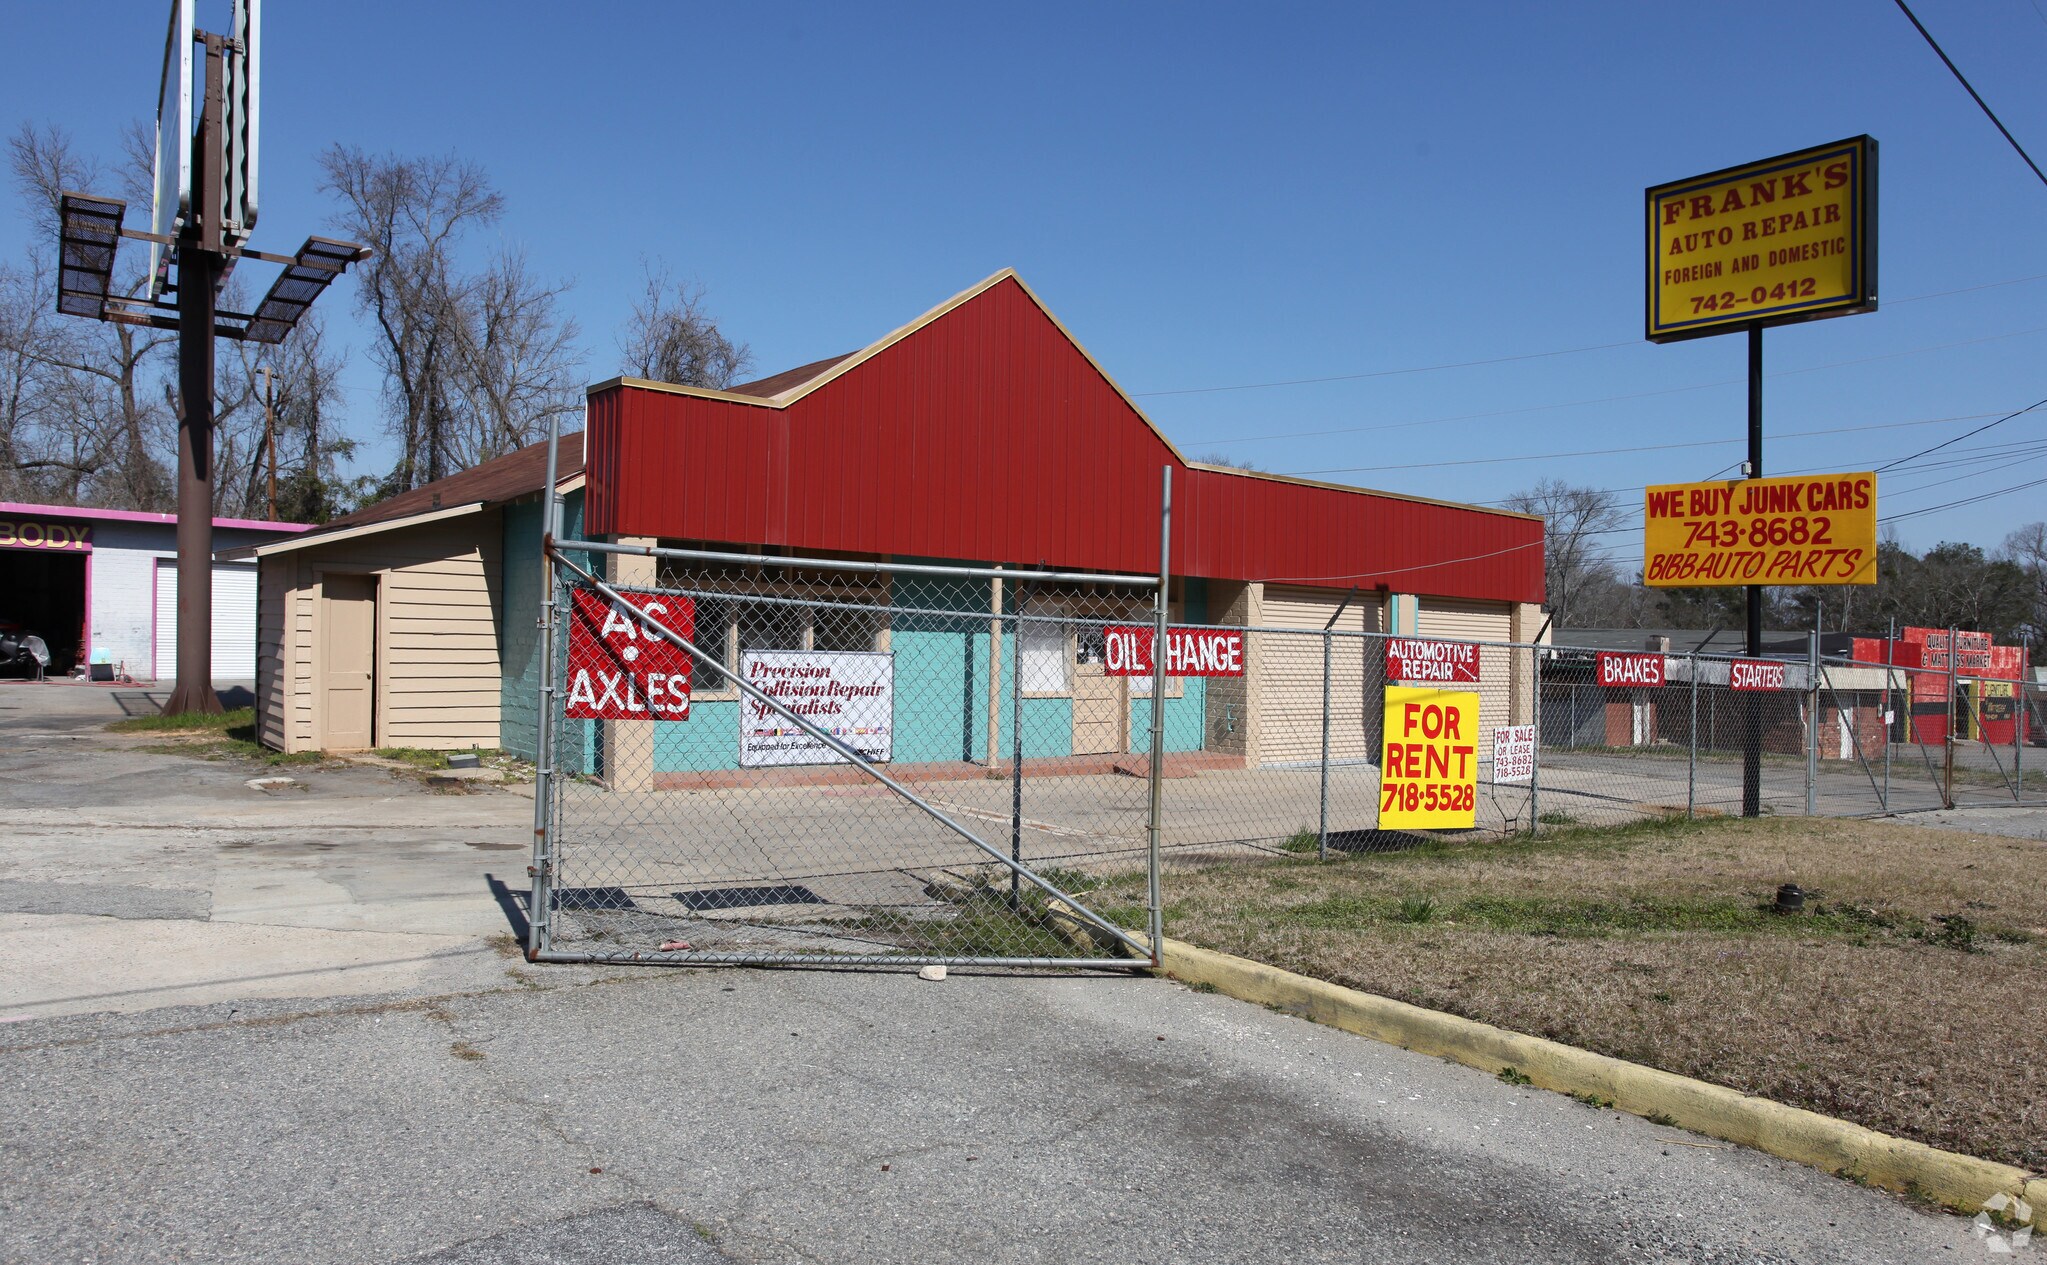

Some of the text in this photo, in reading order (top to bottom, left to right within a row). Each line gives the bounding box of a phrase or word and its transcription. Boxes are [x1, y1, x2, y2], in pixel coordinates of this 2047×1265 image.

[1663, 161, 1848, 226] FRANK'S
[1669, 203, 1841, 255] AUTO REPAIR
[1665, 236, 1846, 285] FOREIGN AND DOMESTIC
[1690, 277, 1817, 314] 742-0412
[1648, 479, 1871, 518] WE BUY JUNK CARS
[0, 521, 90, 549] BODY
[1765, 548, 1863, 578] PARTS
[1106, 632, 1146, 670] OIL
[1389, 640, 1474, 663] AUTOMOTIVE
[1927, 634, 1949, 650] QUALIT
[750, 661, 831, 678] Precision
[1402, 660, 1454, 680] REPAIR
[1603, 656, 1659, 683] BRAKES
[1931, 652, 1965, 668] MATTSS
[1732, 663, 1783, 688] STARTERS
[567, 668, 689, 713] AXLES
[825, 680, 885, 701] Repair
[1403, 703, 1460, 740] FOR
[1496, 727, 1533, 744] FOR SALE
[1386, 743, 1474, 779] RENT
[1496, 755, 1532, 767] 743-8682
[1498, 744, 1531, 756] OR LEASE
[1496, 765, 1531, 778] 718-5528
